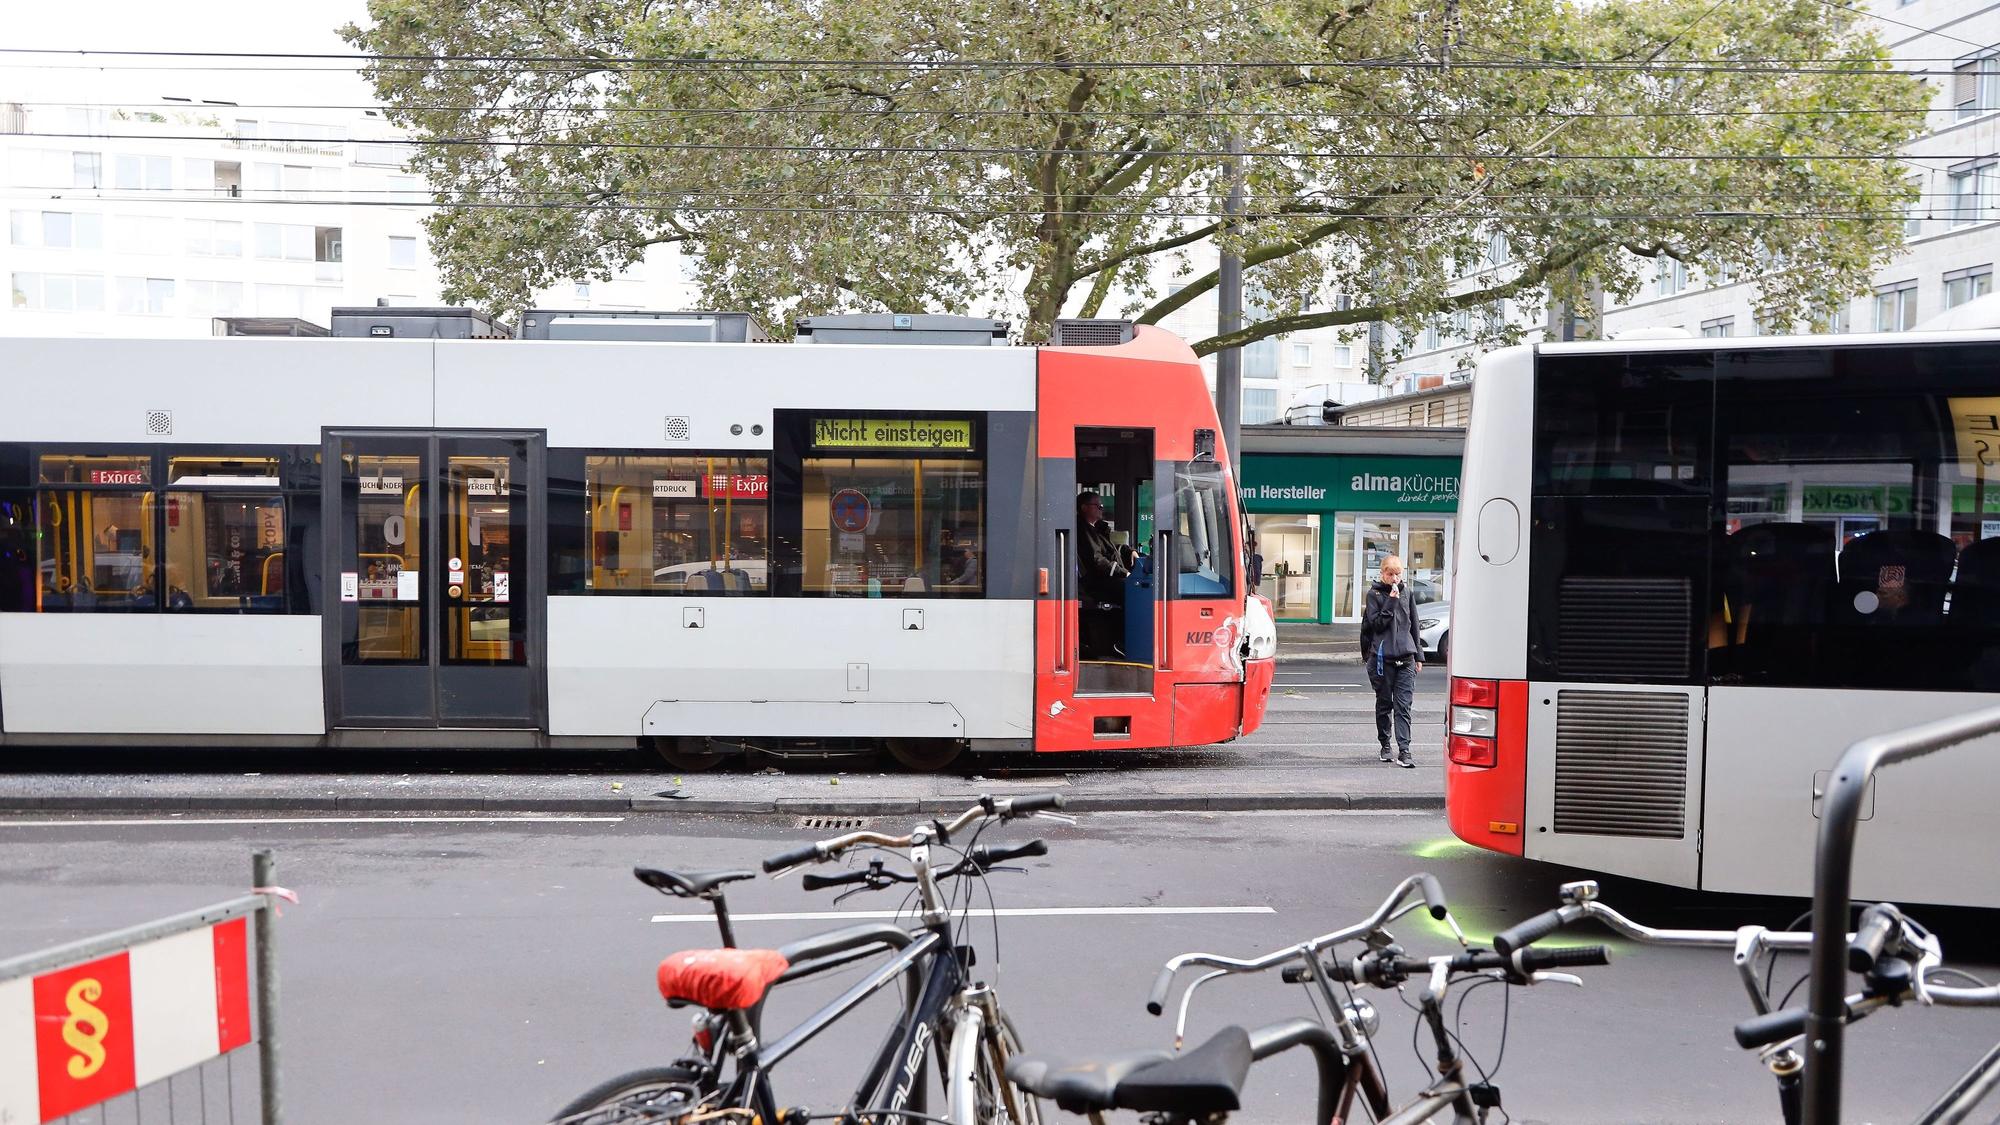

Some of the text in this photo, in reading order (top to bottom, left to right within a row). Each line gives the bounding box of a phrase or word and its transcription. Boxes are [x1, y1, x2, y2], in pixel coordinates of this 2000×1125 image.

[819, 420, 964, 447] Nicht einsteigen
[652, 485, 688, 493] RTDRUCK
[1260, 484, 1327, 500] Hersteller
[1397, 492, 1429, 503] direkt
[1186, 631, 1214, 644] KVB
